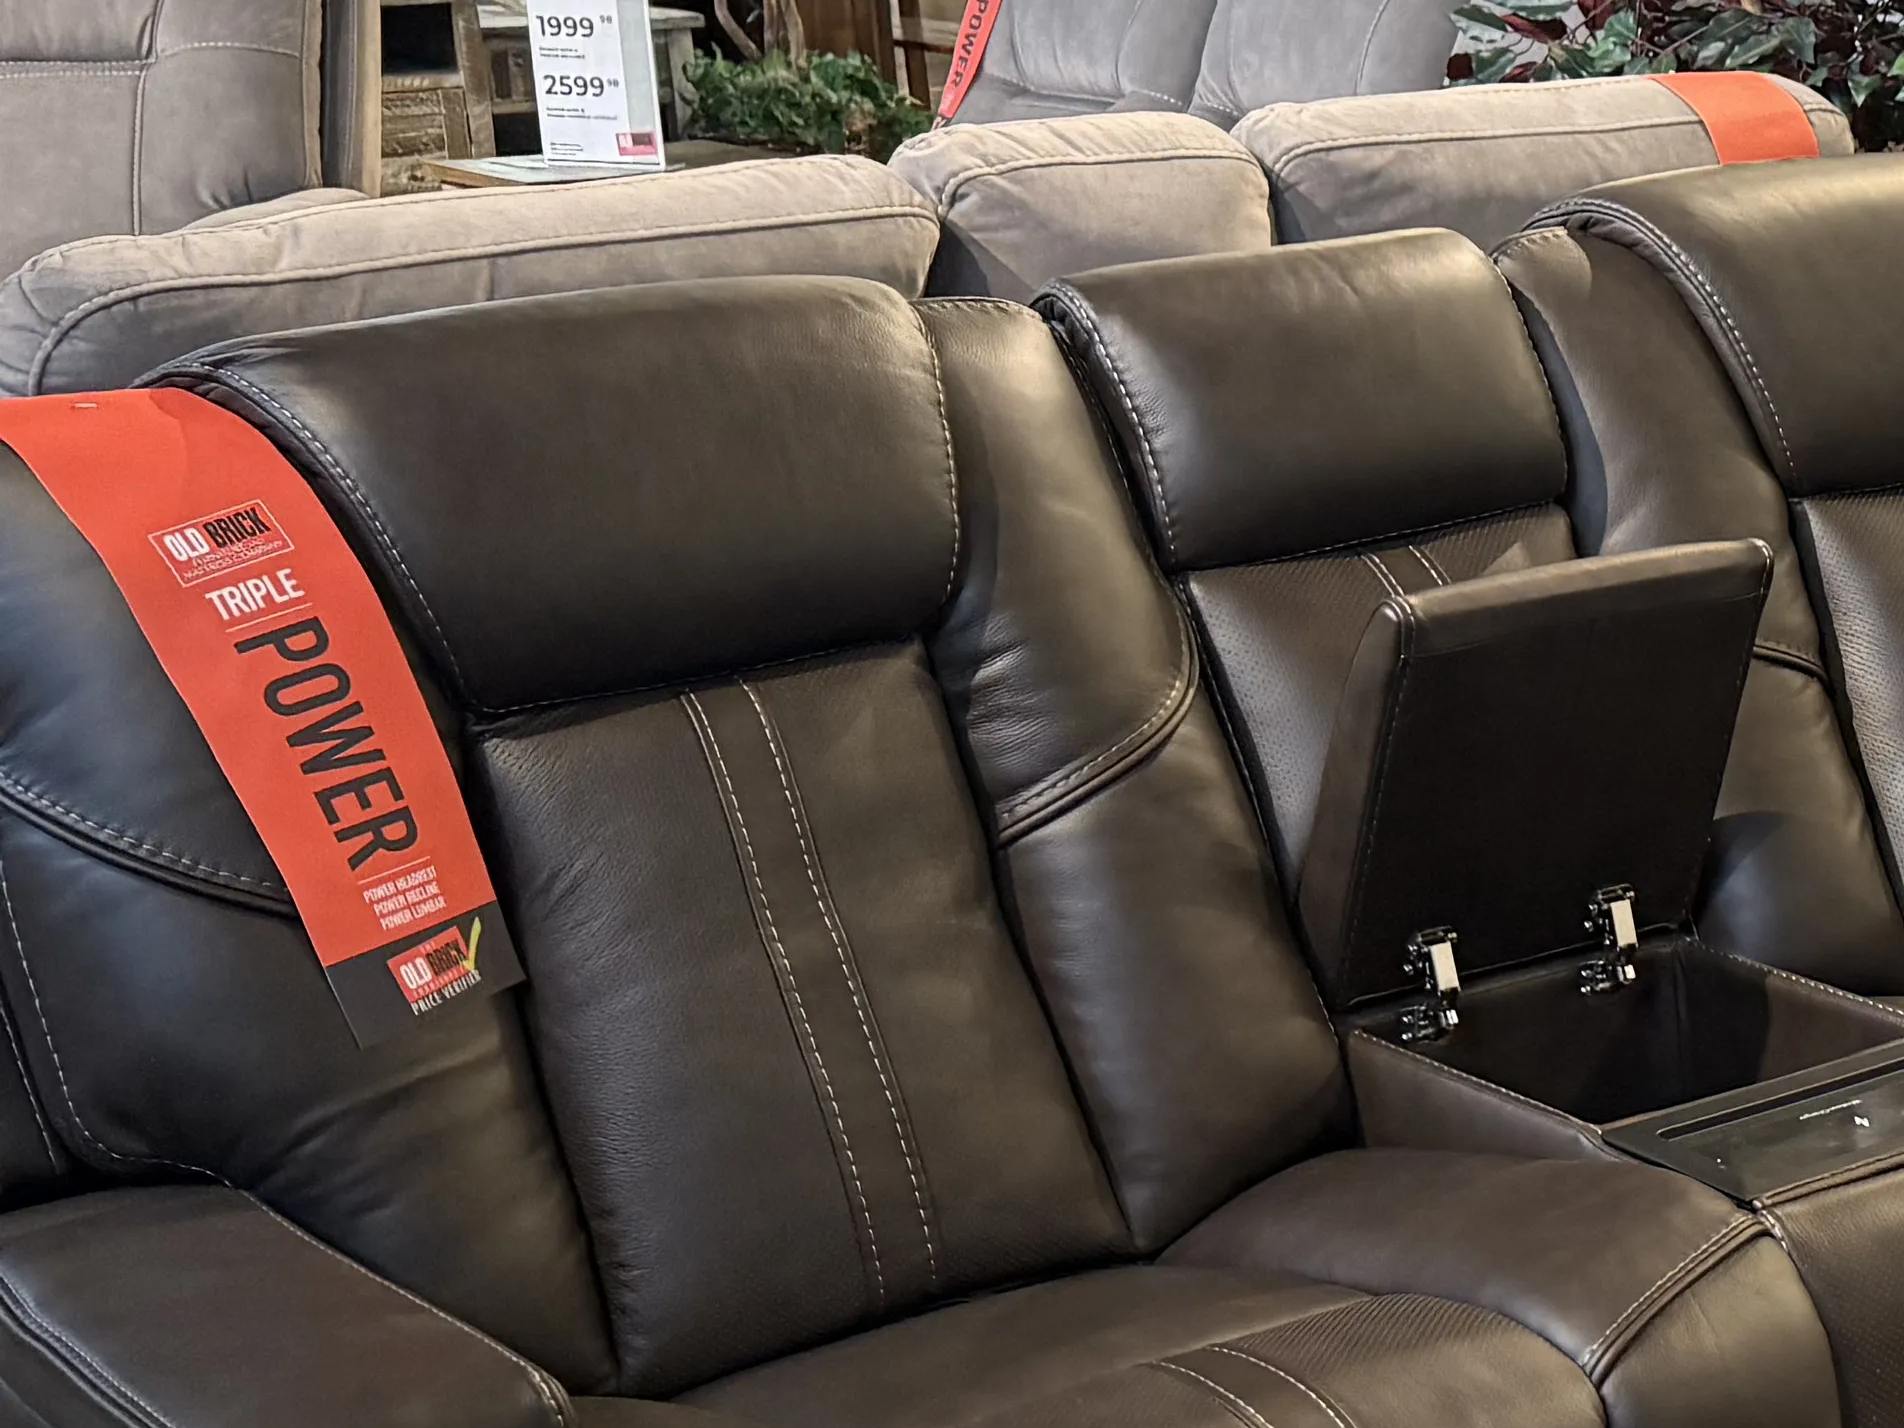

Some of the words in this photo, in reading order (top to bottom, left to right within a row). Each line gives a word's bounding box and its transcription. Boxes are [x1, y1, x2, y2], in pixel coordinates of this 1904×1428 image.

[536, 15, 594, 38] 1999
[543, 75, 605, 98] 2599
[163, 527, 211, 562] OLD
[202, 507, 271, 549] BRICK
[205, 568, 305, 621] TRIPLE
[233, 616, 418, 872] POWER
[363, 881, 397, 904] POWER
[373, 894, 408, 917] POWER
[380, 909, 413, 931] POWER
[400, 957, 433, 990] OLD
[425, 938, 469, 976] BRICK
[410, 990, 442, 1016] PRICE
